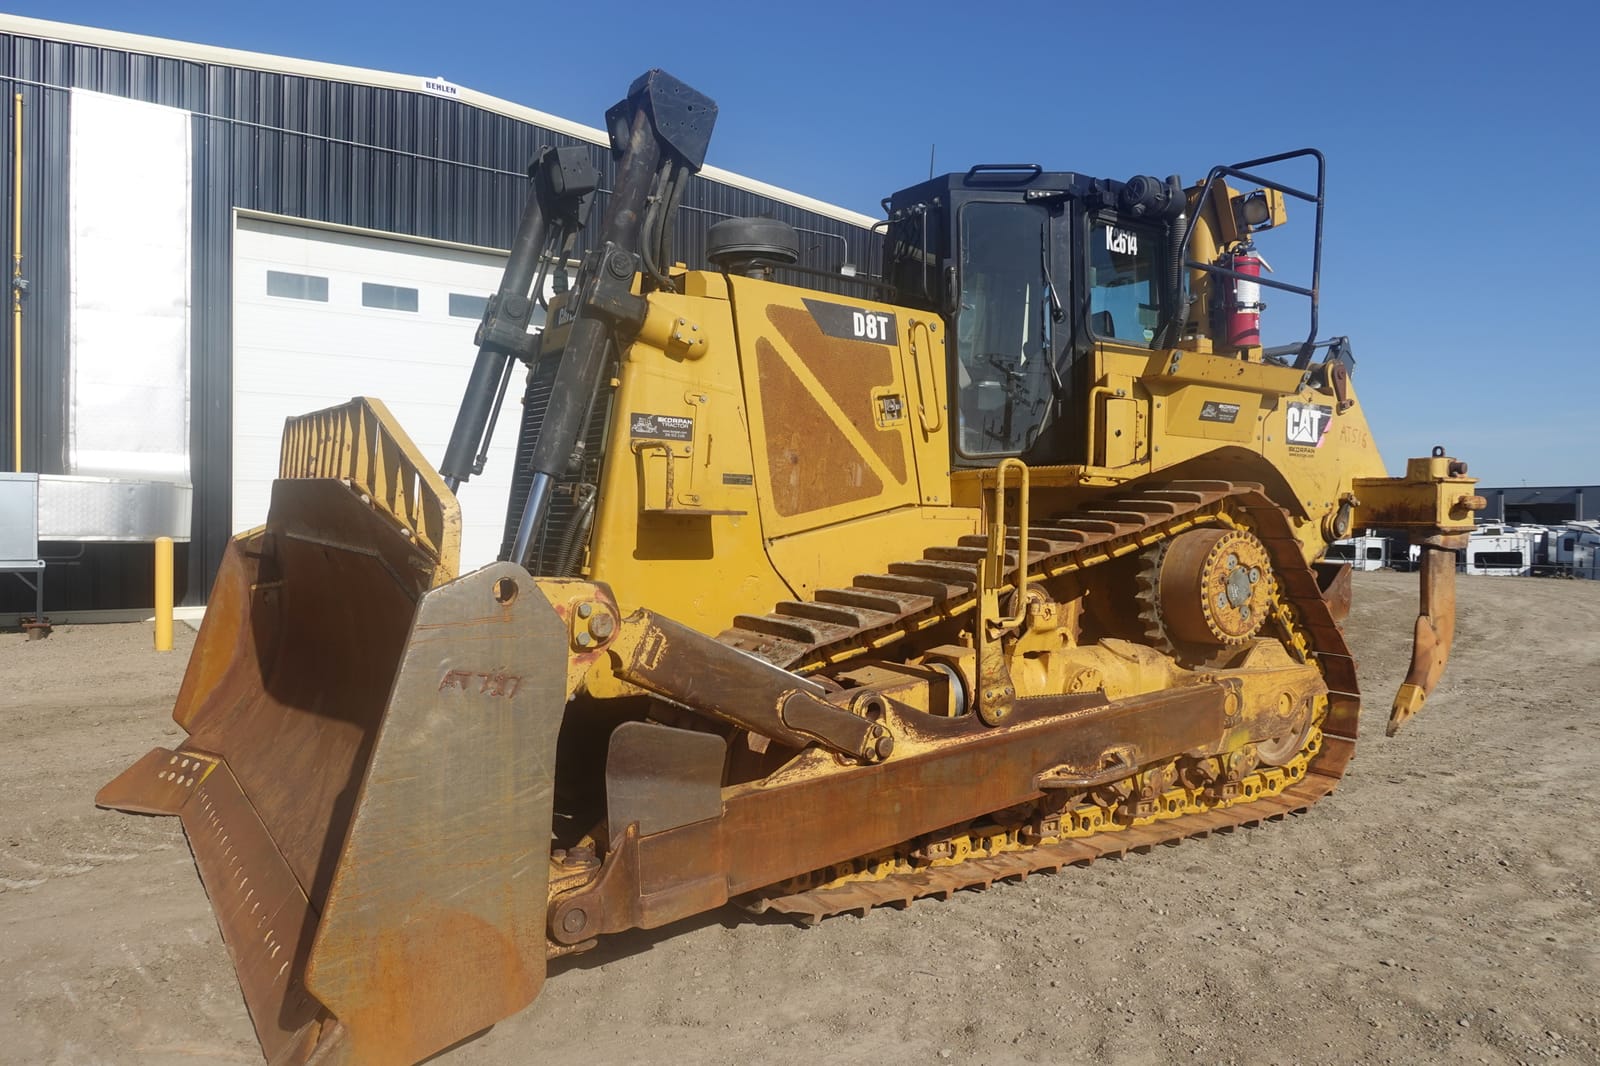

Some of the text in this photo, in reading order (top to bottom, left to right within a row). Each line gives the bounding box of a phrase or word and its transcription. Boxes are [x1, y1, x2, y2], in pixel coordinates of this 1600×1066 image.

[426, 81, 457, 94] BEHLEN
[1106, 225, 1137, 256] K2614
[853, 311, 889, 340] D8T
[1287, 407, 1321, 443] CAT
